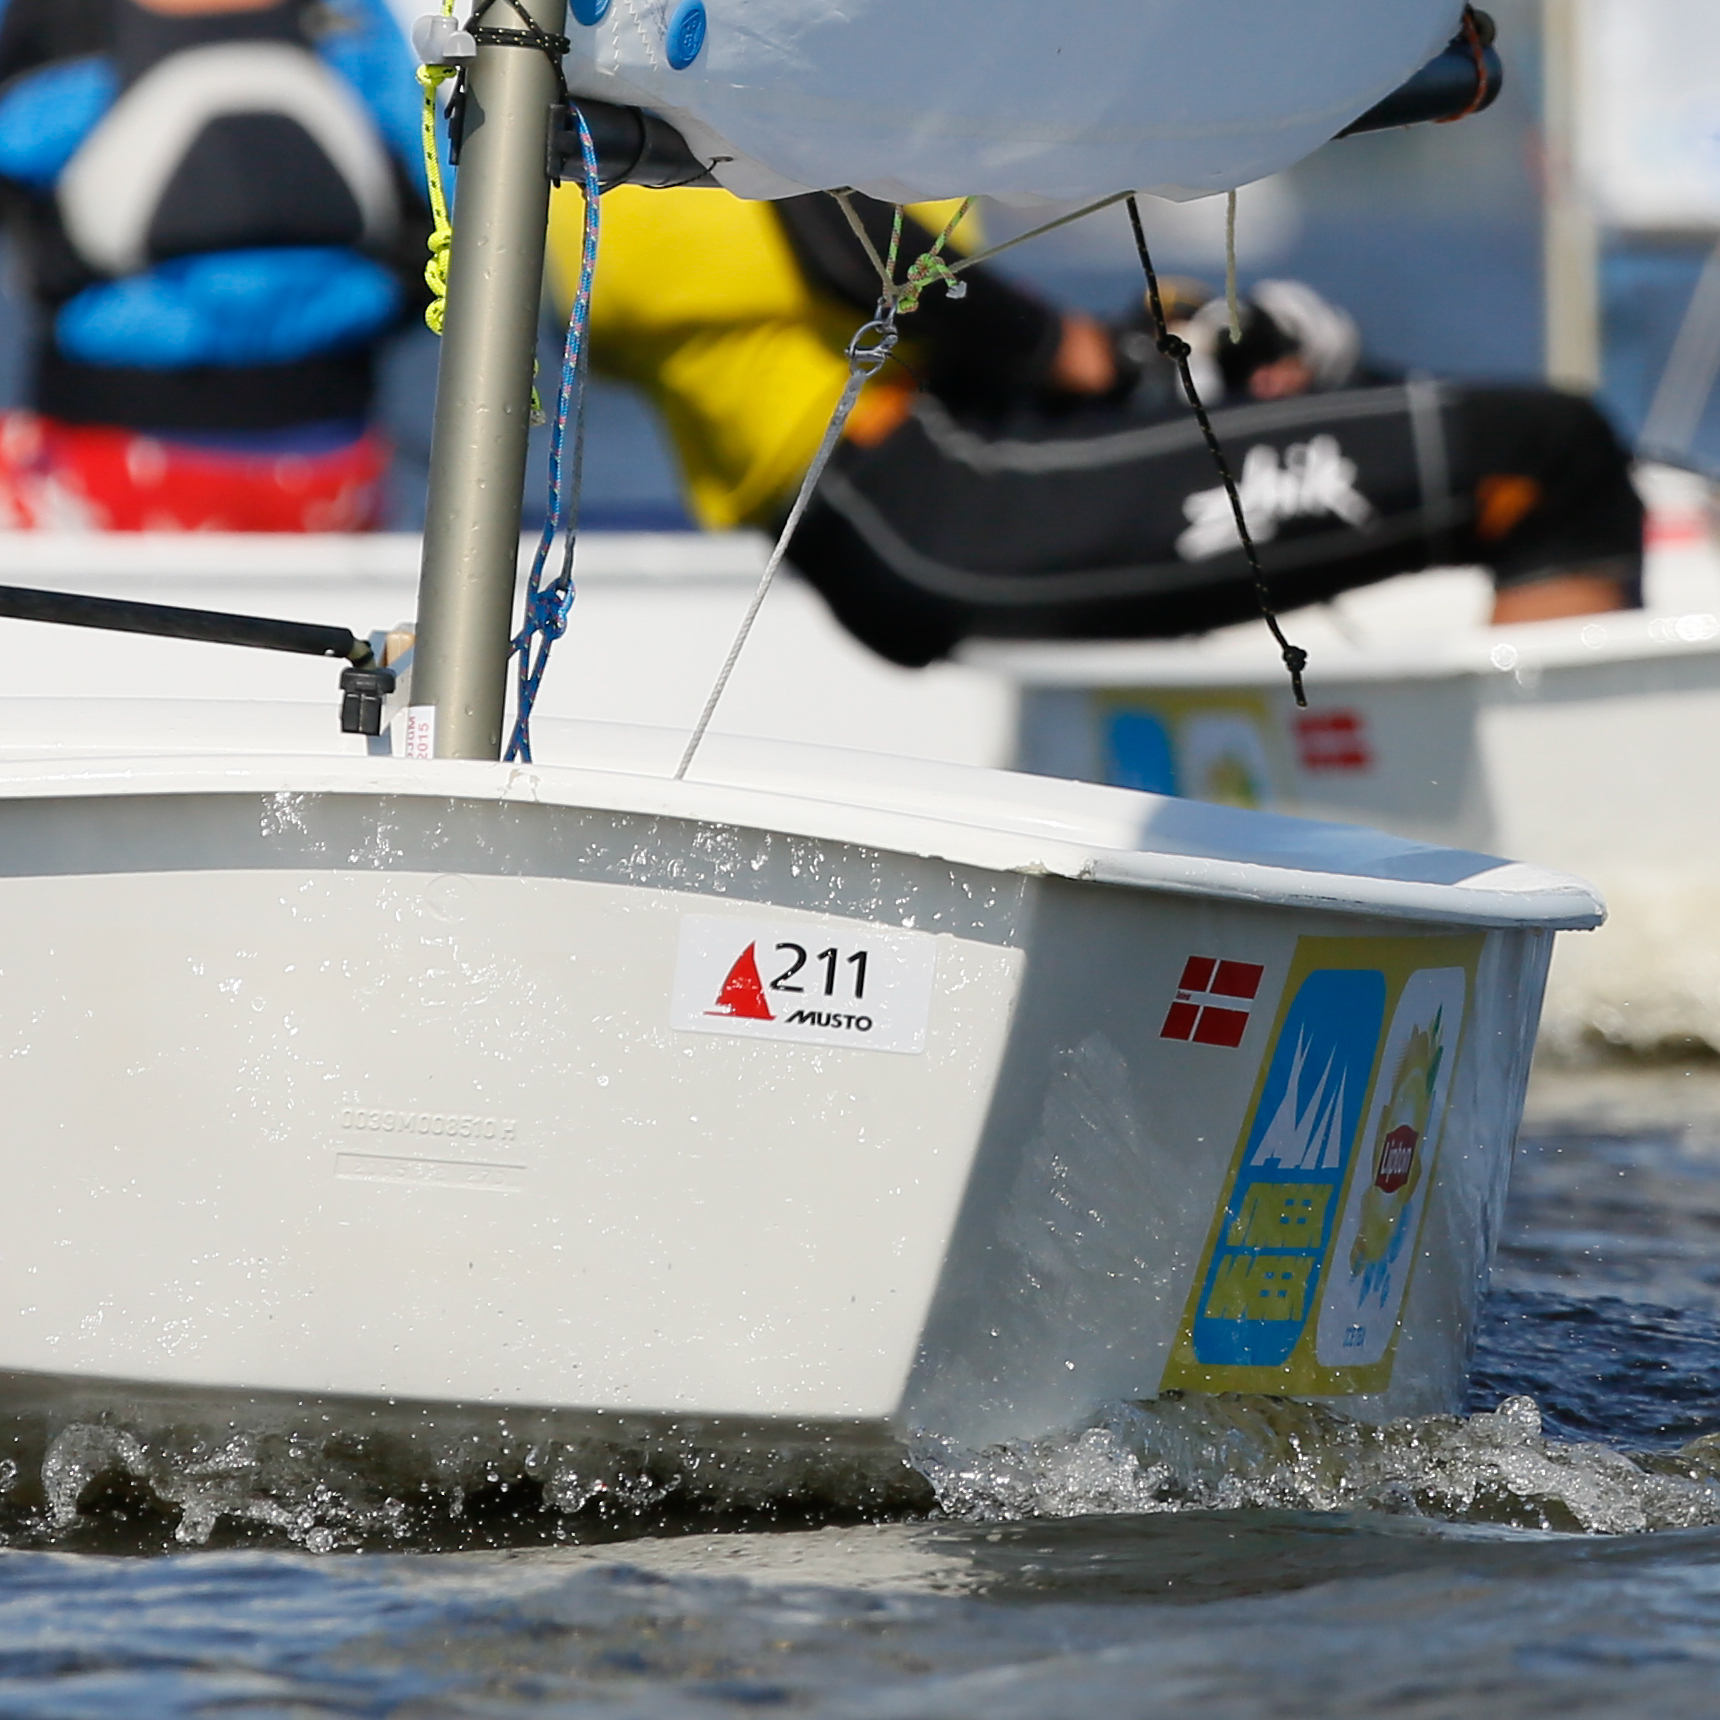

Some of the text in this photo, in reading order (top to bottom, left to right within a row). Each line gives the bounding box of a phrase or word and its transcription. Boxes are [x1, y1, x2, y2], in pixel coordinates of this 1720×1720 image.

[769, 942, 868, 1000] 211
[784, 1010, 873, 1033] MUSTO
[1380, 1138, 1414, 1184] Lipton
